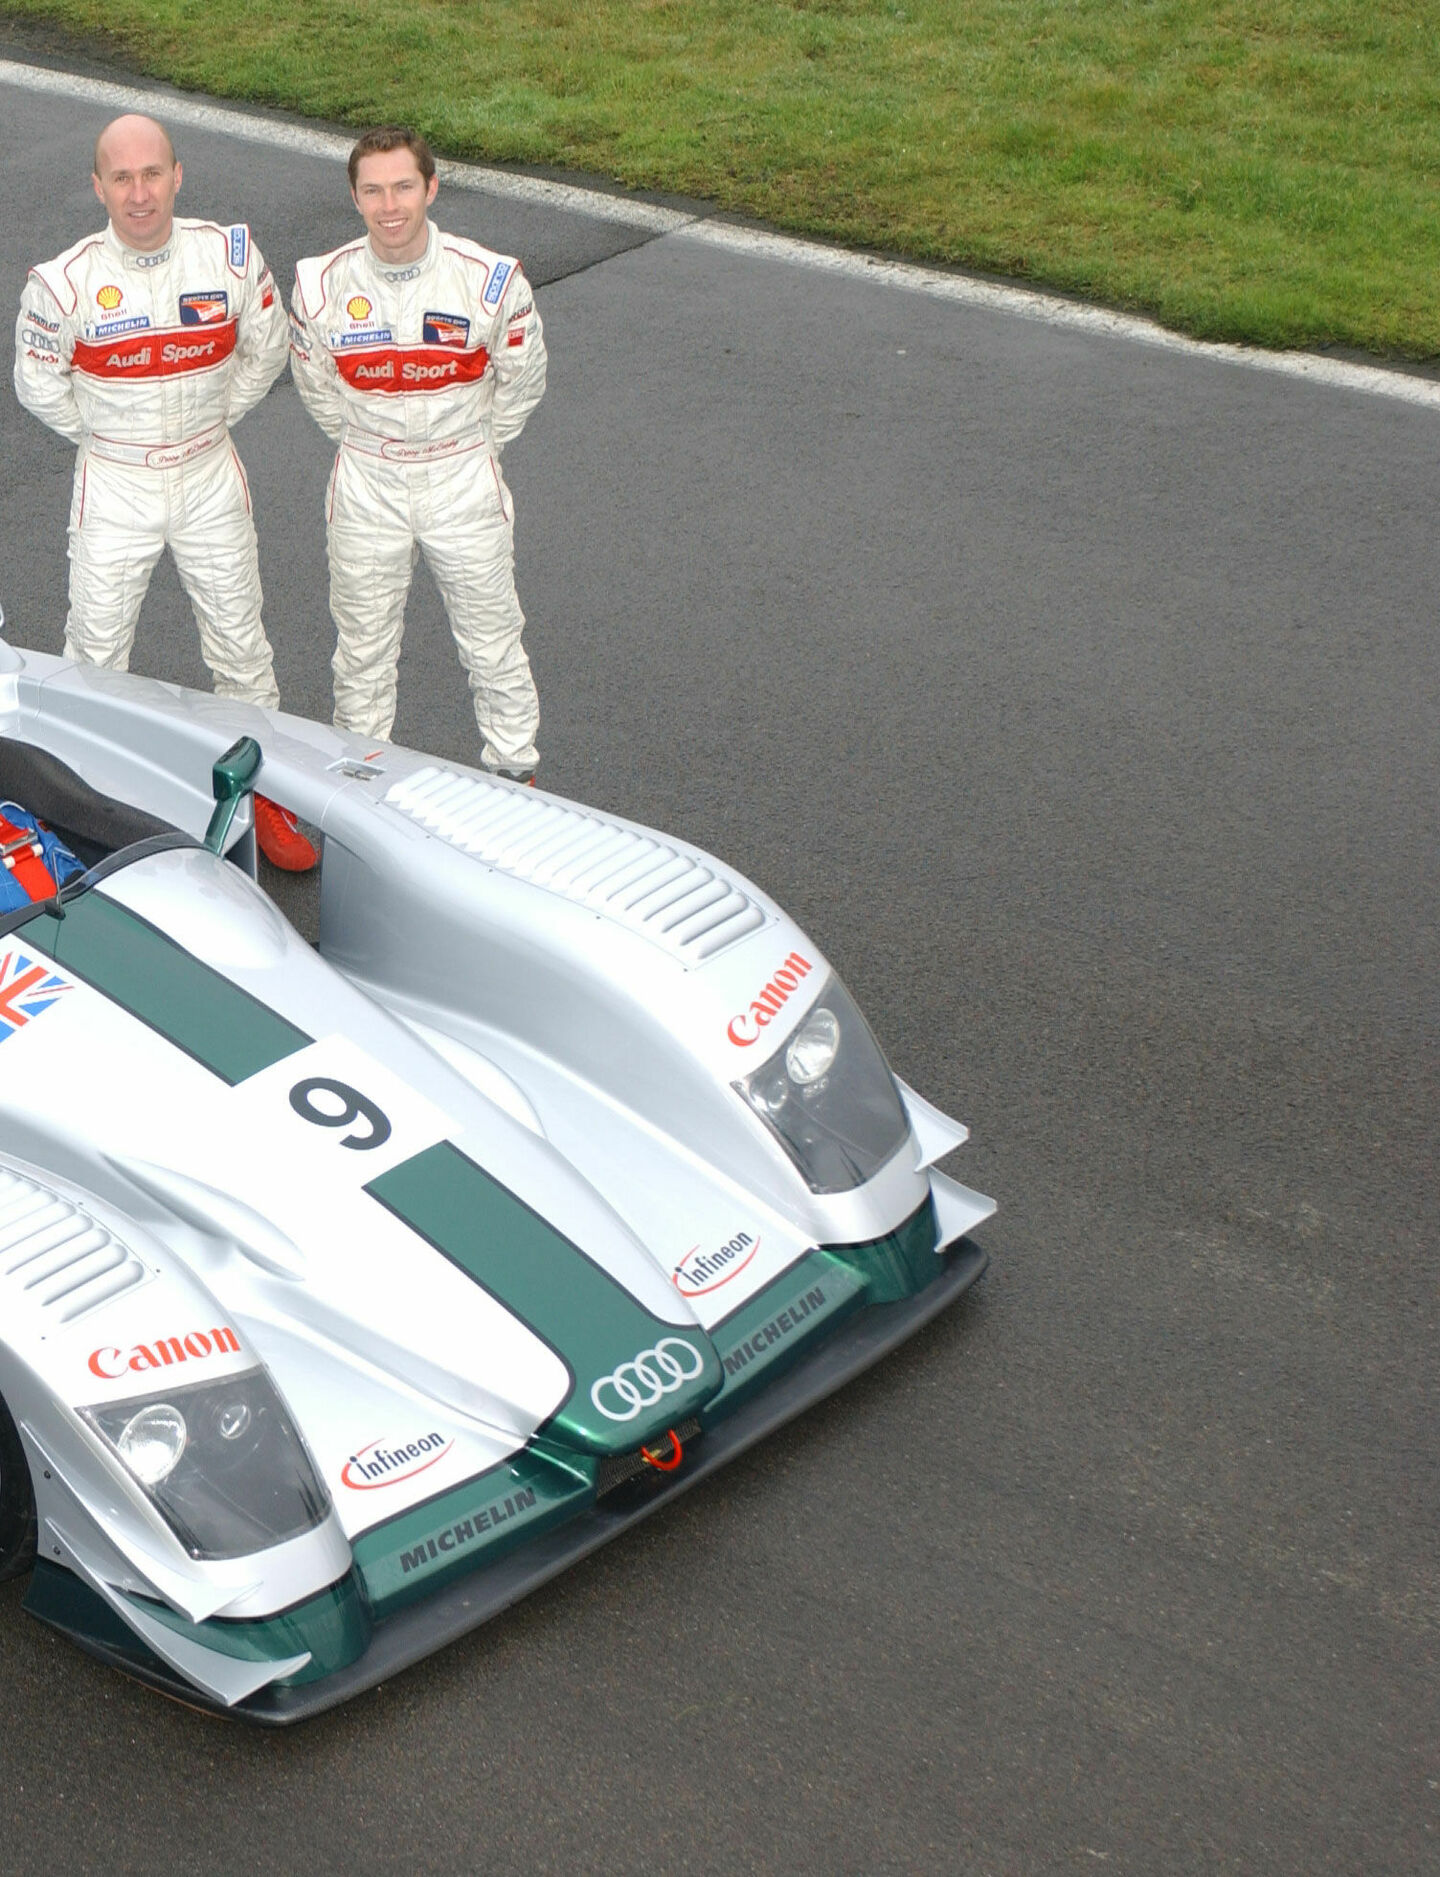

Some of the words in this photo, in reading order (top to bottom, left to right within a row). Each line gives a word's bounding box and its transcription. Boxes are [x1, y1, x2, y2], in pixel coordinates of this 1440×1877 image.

[98, 318, 148, 336] MICHELIN
[344, 331, 391, 345] MICHELIN
[106, 347, 151, 368] Audi
[161, 341, 215, 363] Sport
[355, 360, 394, 379] Audi
[401, 360, 458, 381] Sport
[727, 950, 814, 1048] Canon
[288, 1076, 392, 1151] 9
[87, 1326, 241, 1380] Canon
[722, 1285, 826, 1377] MICHELIN
[399, 1486, 539, 1574] MICHELIN
